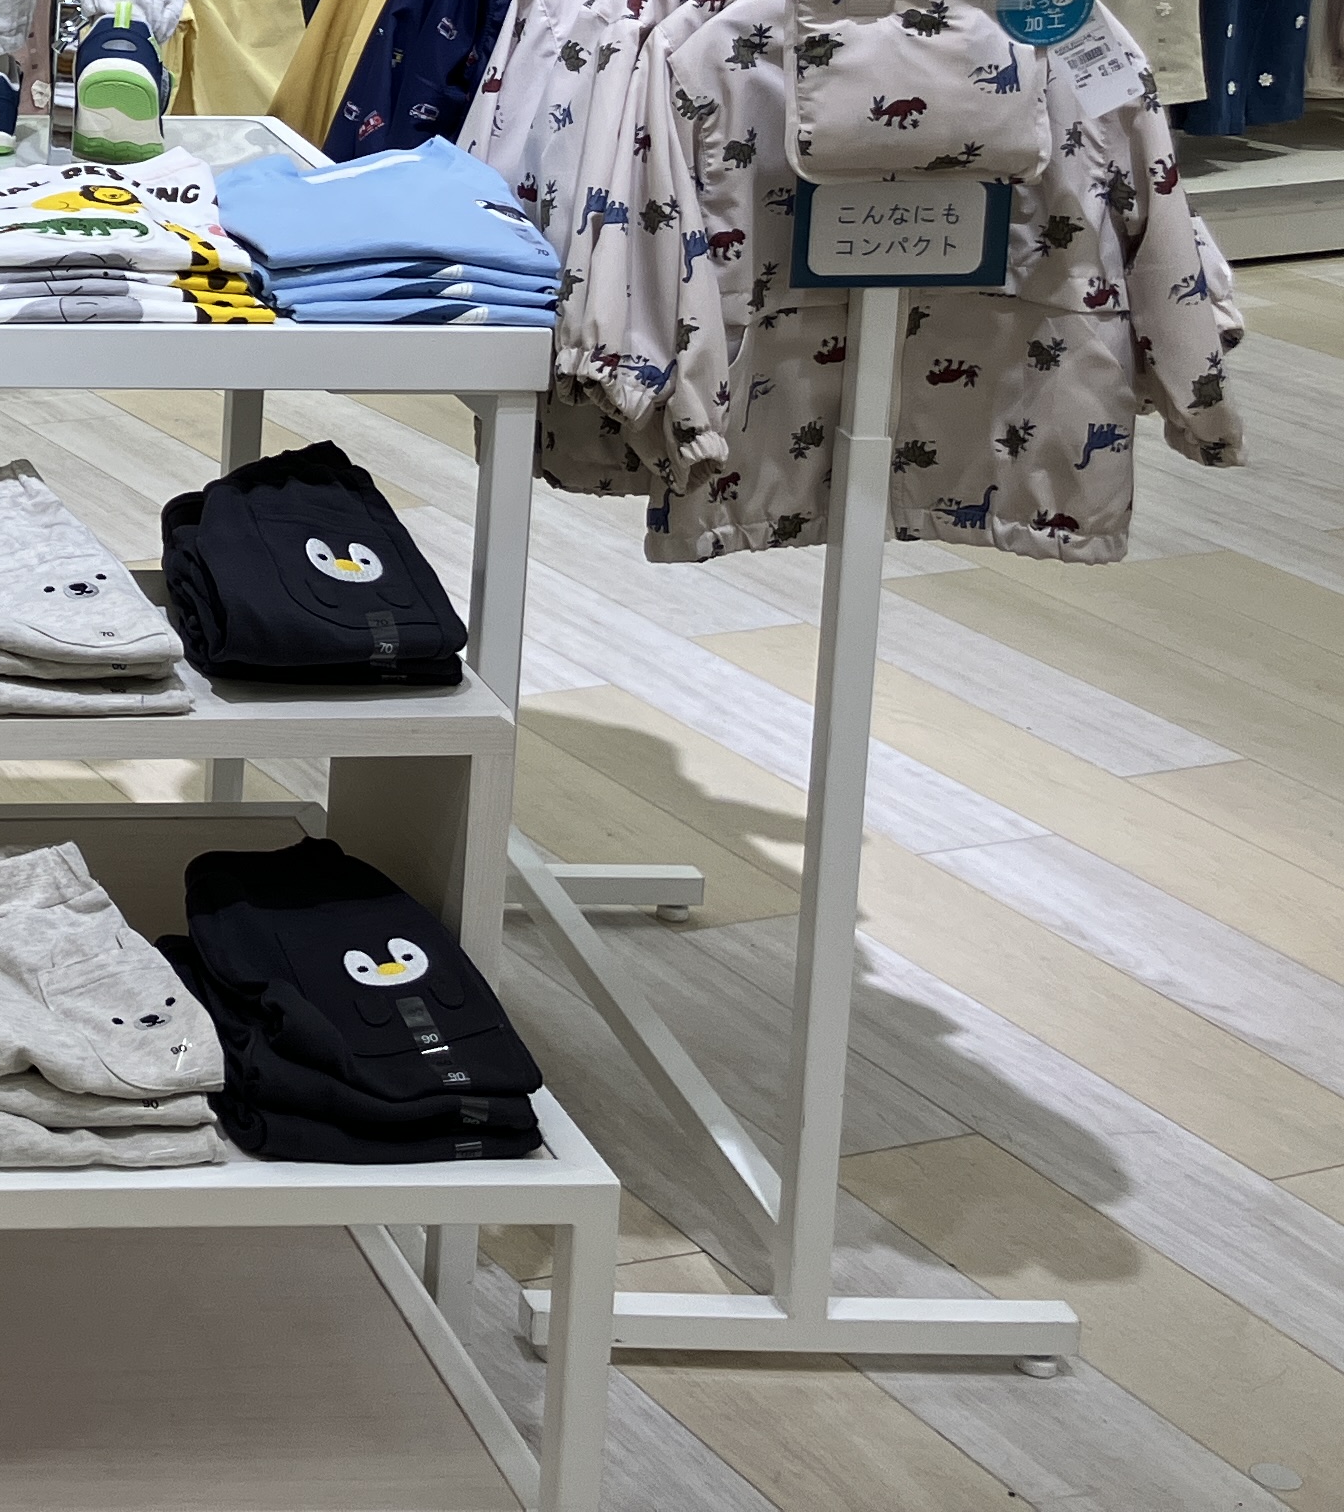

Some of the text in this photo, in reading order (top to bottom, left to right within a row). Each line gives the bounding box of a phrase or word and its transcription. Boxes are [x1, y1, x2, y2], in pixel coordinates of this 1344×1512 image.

[1024, 12, 1066, 33] 加工
[838, 203, 960, 225] こんなにも
[835, 236, 957, 256] コンパクト
[536, 247, 550, 257] 70
[99, 630, 115, 638] 70
[379, 643, 393, 654] 70
[421, 1033, 439, 1044] 90
[448, 1072, 466, 1081] 90
